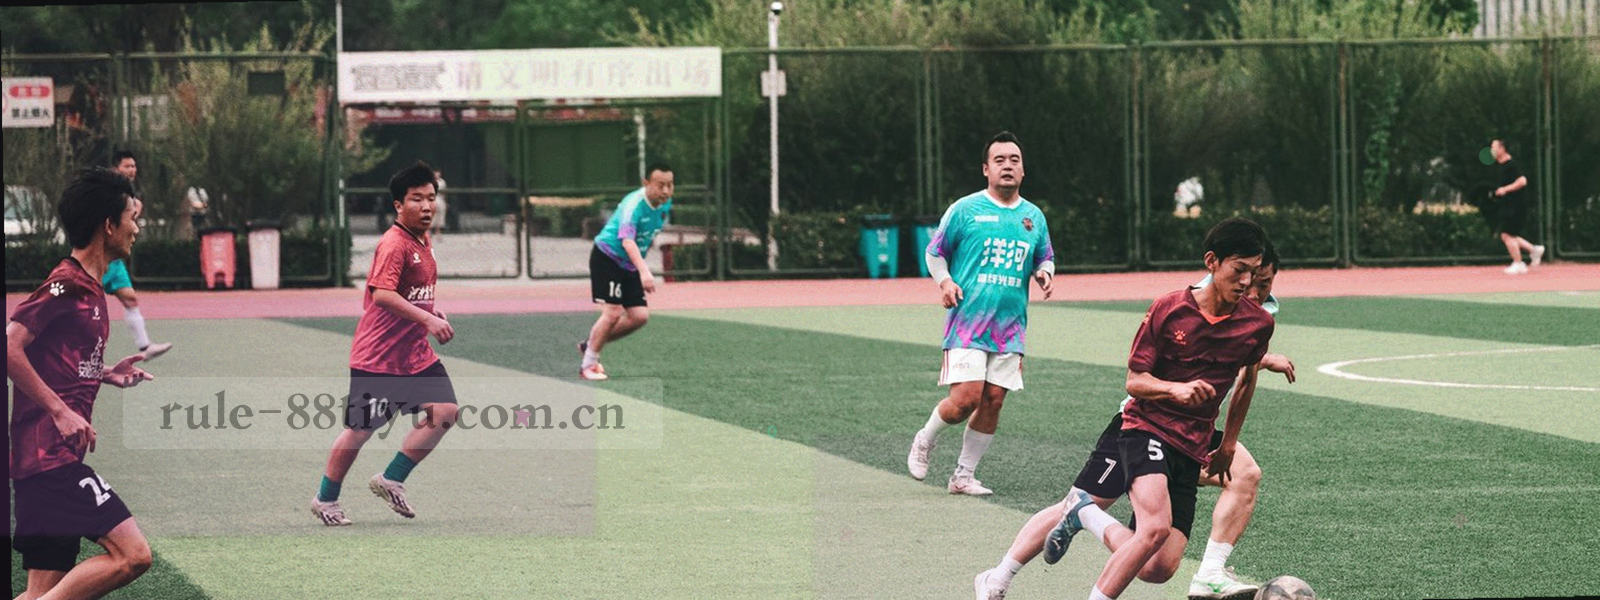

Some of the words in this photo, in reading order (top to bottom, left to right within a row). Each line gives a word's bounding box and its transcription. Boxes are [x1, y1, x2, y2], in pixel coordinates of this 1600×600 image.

[980, 237, 1030, 272] 洋河
[609, 281, 622, 298] 16
[368, 397, 389, 419] 10
[1147, 438, 1164, 461] 5
[1097, 457, 1117, 484] 7
